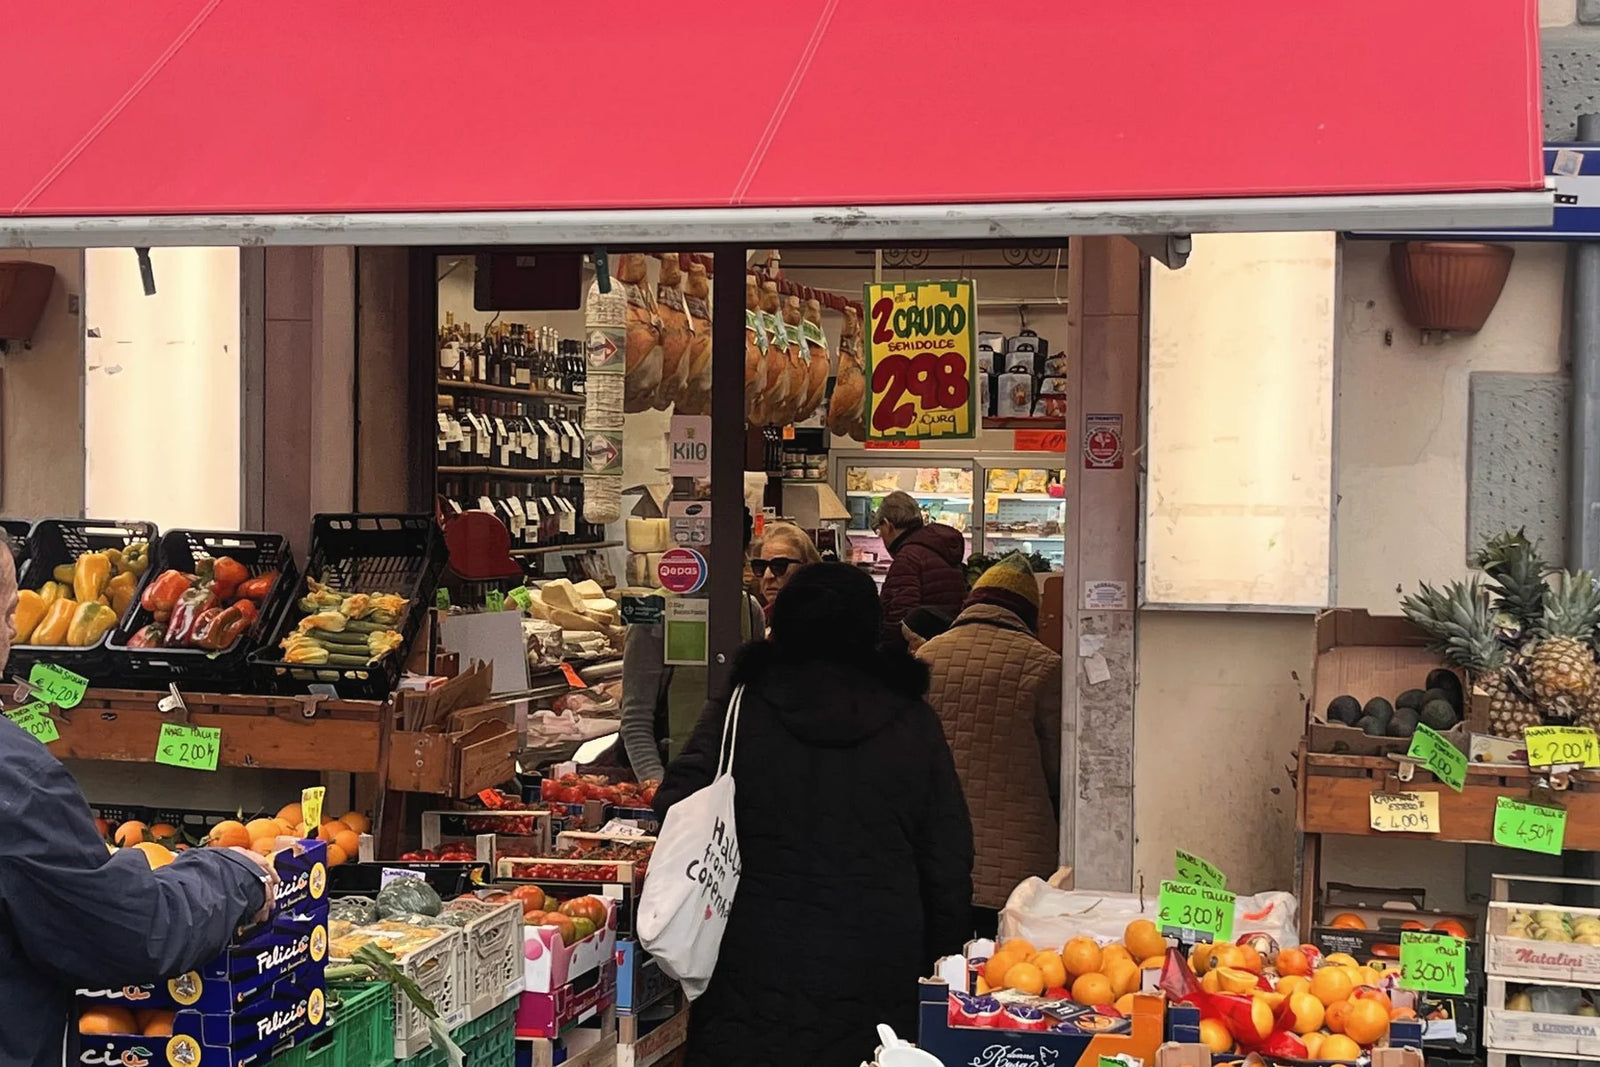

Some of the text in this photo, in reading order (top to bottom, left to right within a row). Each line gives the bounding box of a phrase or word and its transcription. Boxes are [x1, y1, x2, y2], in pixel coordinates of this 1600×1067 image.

[872, 297, 966, 344] 2 CRUDO
[1159, 906, 1171, 921] €
[1515, 948, 1583, 967] Natalini
